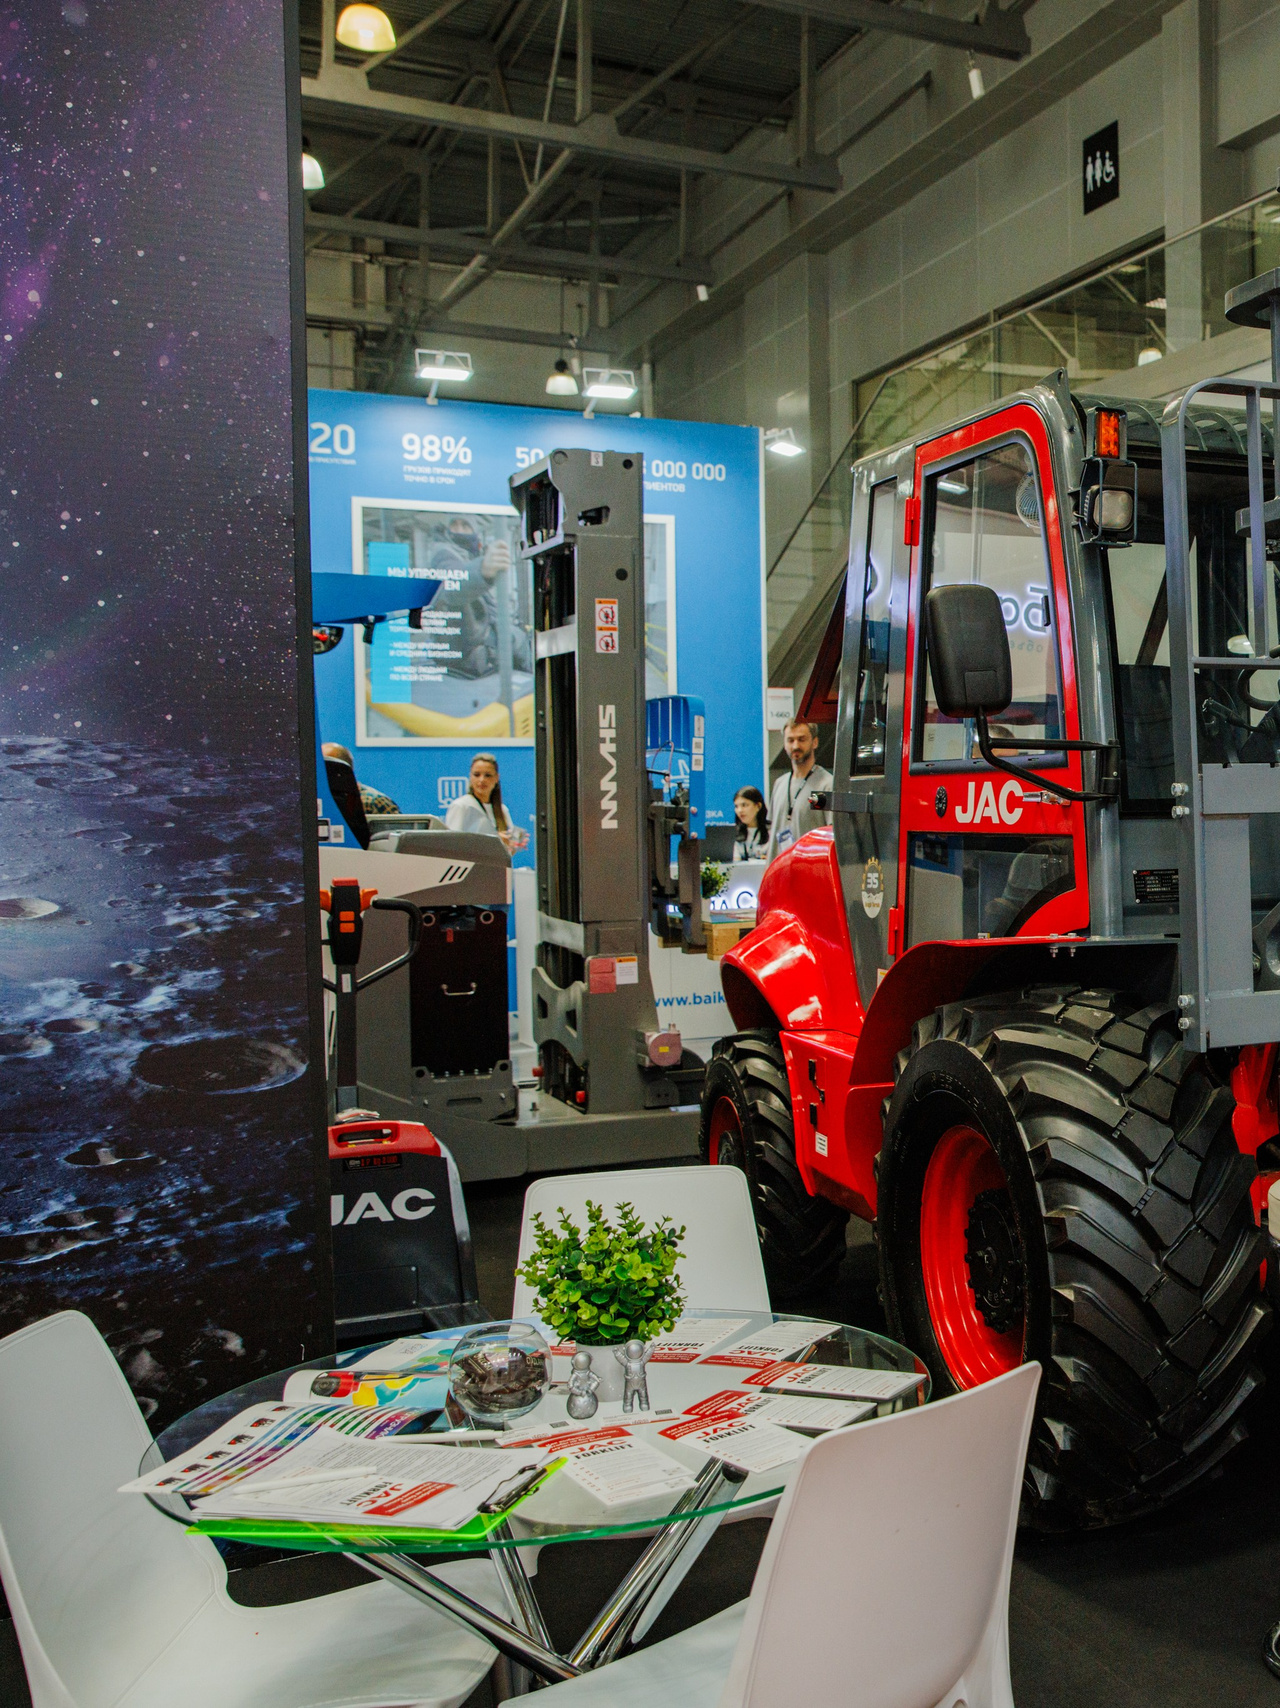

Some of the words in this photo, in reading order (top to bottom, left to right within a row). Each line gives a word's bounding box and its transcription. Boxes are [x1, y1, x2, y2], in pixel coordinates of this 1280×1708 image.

[402, 432, 473, 464] 98%
[651, 459, 687, 479] 000
[691, 463, 727, 481] 000
[955, 779, 1024, 825] JAC
[787, 1366, 818, 1383] JAC
[696, 1420, 747, 1439] JAC
[702, 1424, 756, 1444] FORKLIFT
[569, 1439, 627, 1455] JAC
[575, 1443, 633, 1459] FORKLIFT
[355, 1482, 404, 1509] JAC
